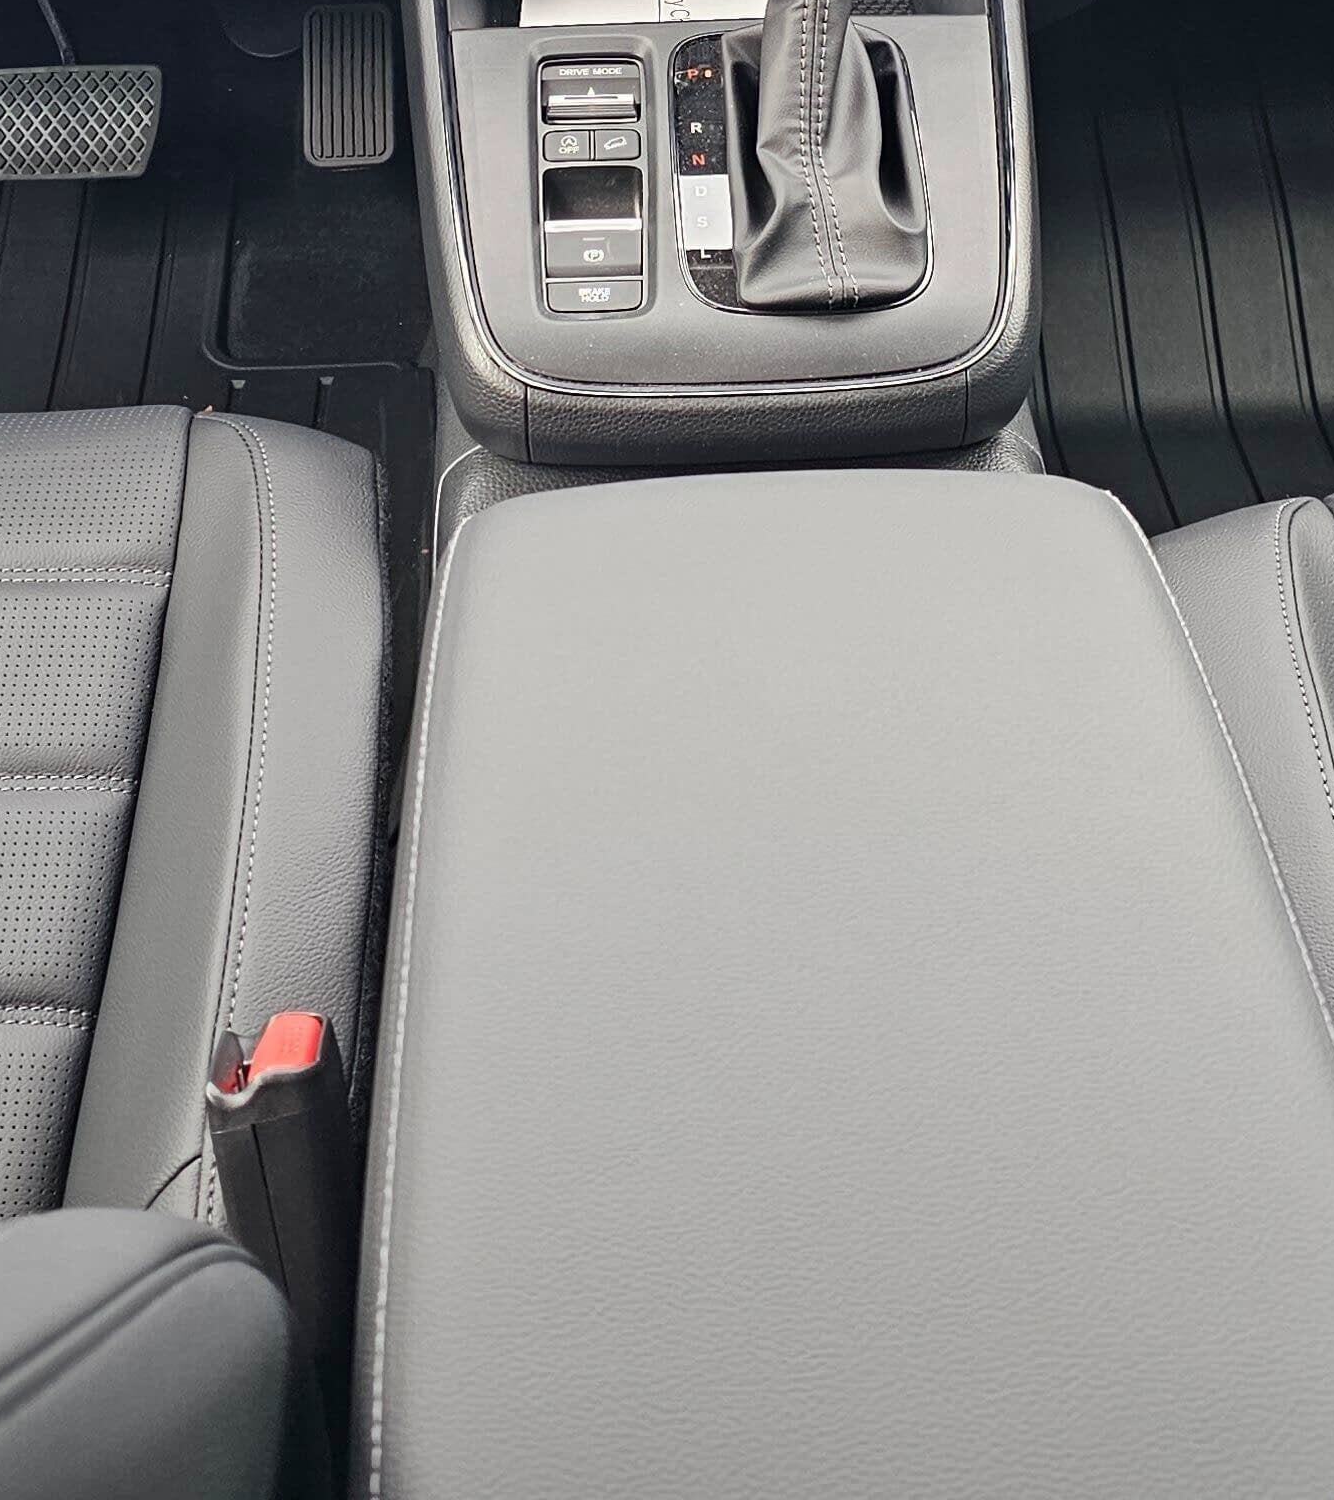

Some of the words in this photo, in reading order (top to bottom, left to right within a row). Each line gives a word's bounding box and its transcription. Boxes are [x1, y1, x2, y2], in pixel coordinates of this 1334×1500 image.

[559, 68, 589, 76] DRIVE
[593, 67, 623, 75] MODE
[687, 68, 699, 79] P
[690, 122, 703, 134] R
[558, 145, 580, 154] OFF
[692, 153, 706, 165] N
[695, 185, 708, 197] D
[697, 215, 709, 228] S
[579, 288, 611, 296] BRAKE
